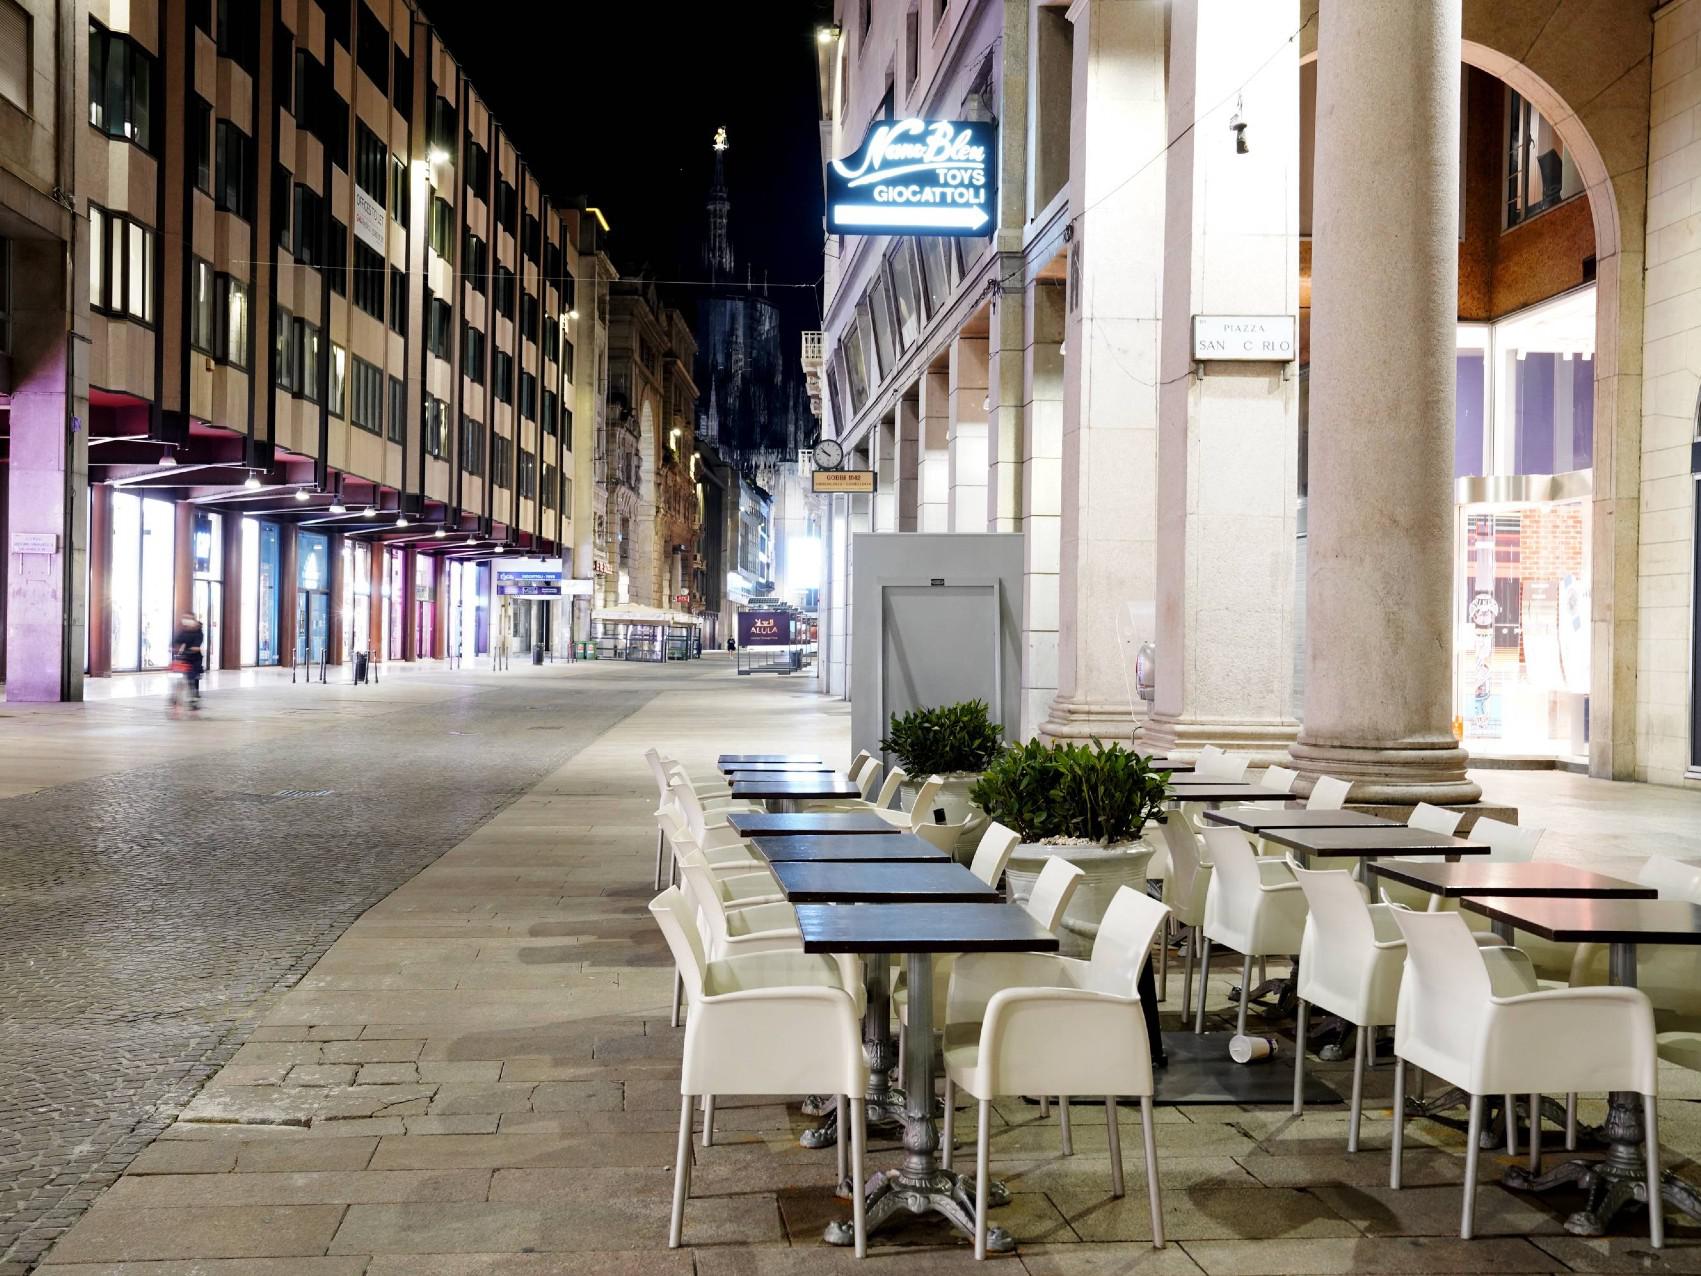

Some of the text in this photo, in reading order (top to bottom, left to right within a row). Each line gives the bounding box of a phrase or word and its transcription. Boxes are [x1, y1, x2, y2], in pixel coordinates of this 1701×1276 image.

[924, 120, 985, 163] Bleu
[936, 169, 985, 185] TOYS
[873, 185, 985, 204] GIOCATTOLI
[1223, 324, 1265, 333] PIAZZA
[1199, 340, 1290, 351] SAN CRLO
[750, 626, 778, 634] ALULA
